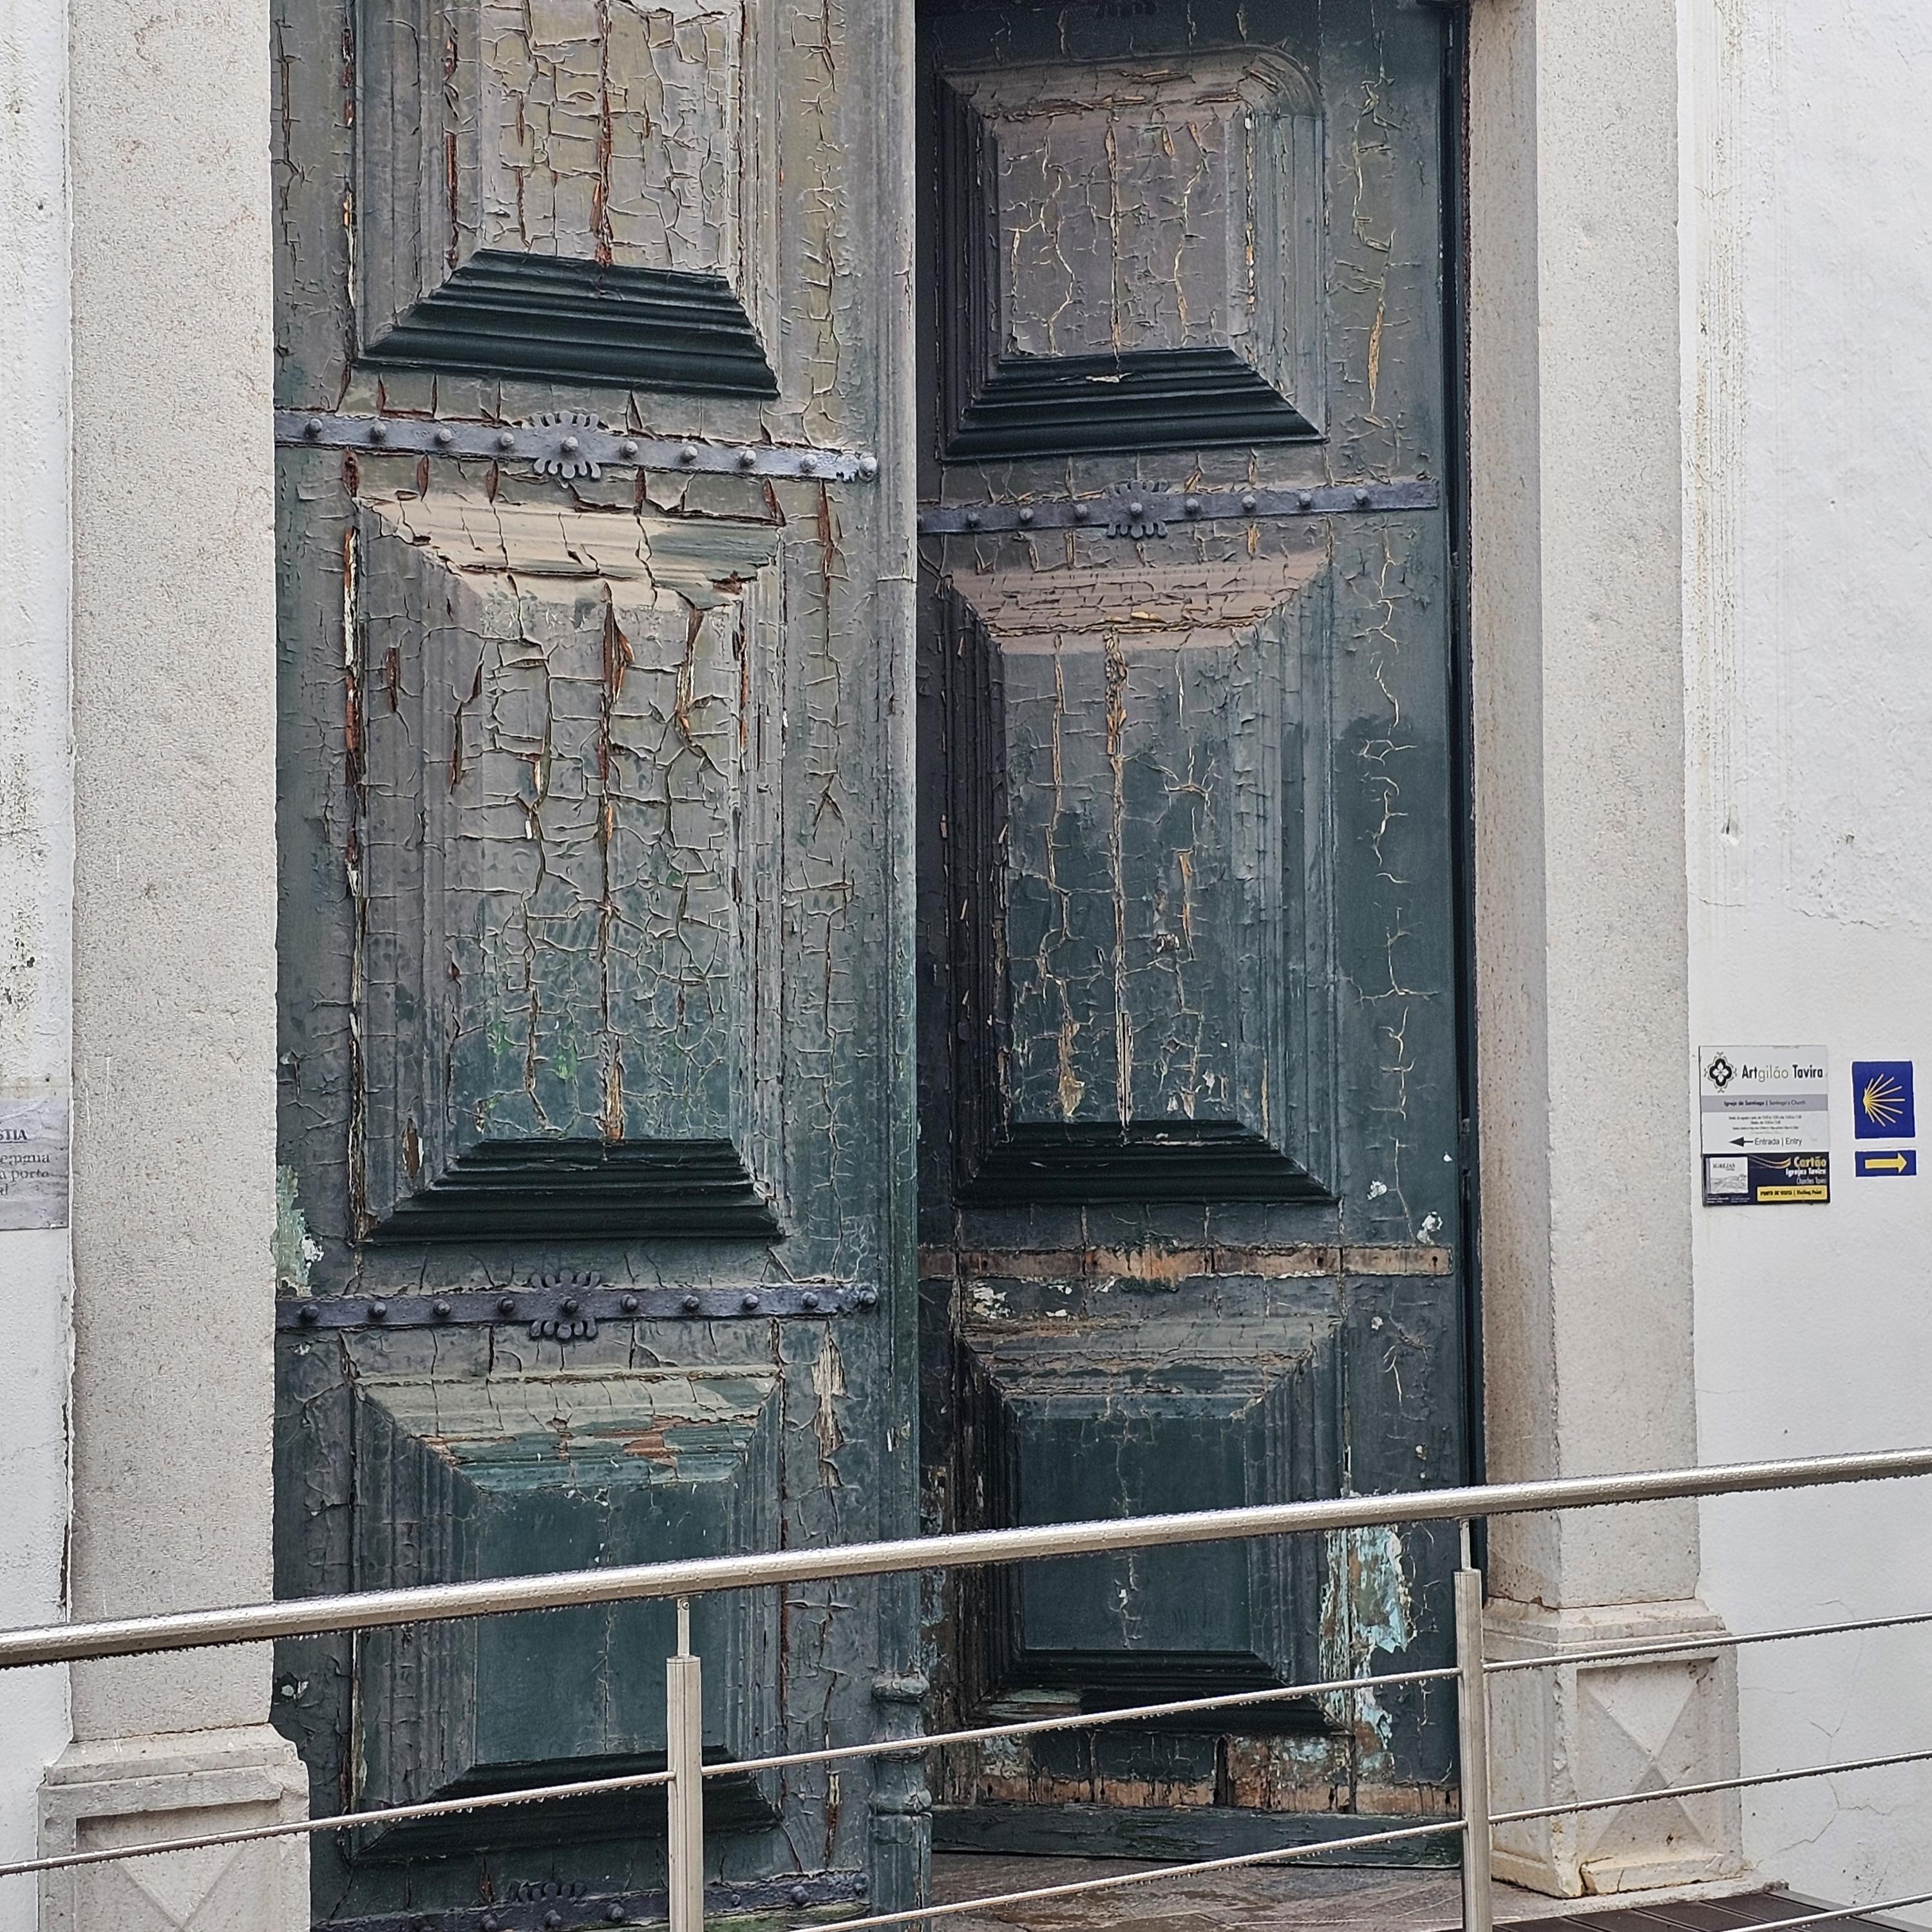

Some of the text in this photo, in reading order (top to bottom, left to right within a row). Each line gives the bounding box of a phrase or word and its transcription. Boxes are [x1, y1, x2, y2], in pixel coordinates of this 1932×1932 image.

[1741, 1065, 1823, 1083] Artgilão Tavira
[1785, 1137, 1803, 1146] Entry
[1794, 1156, 1826, 1168] Cartão
